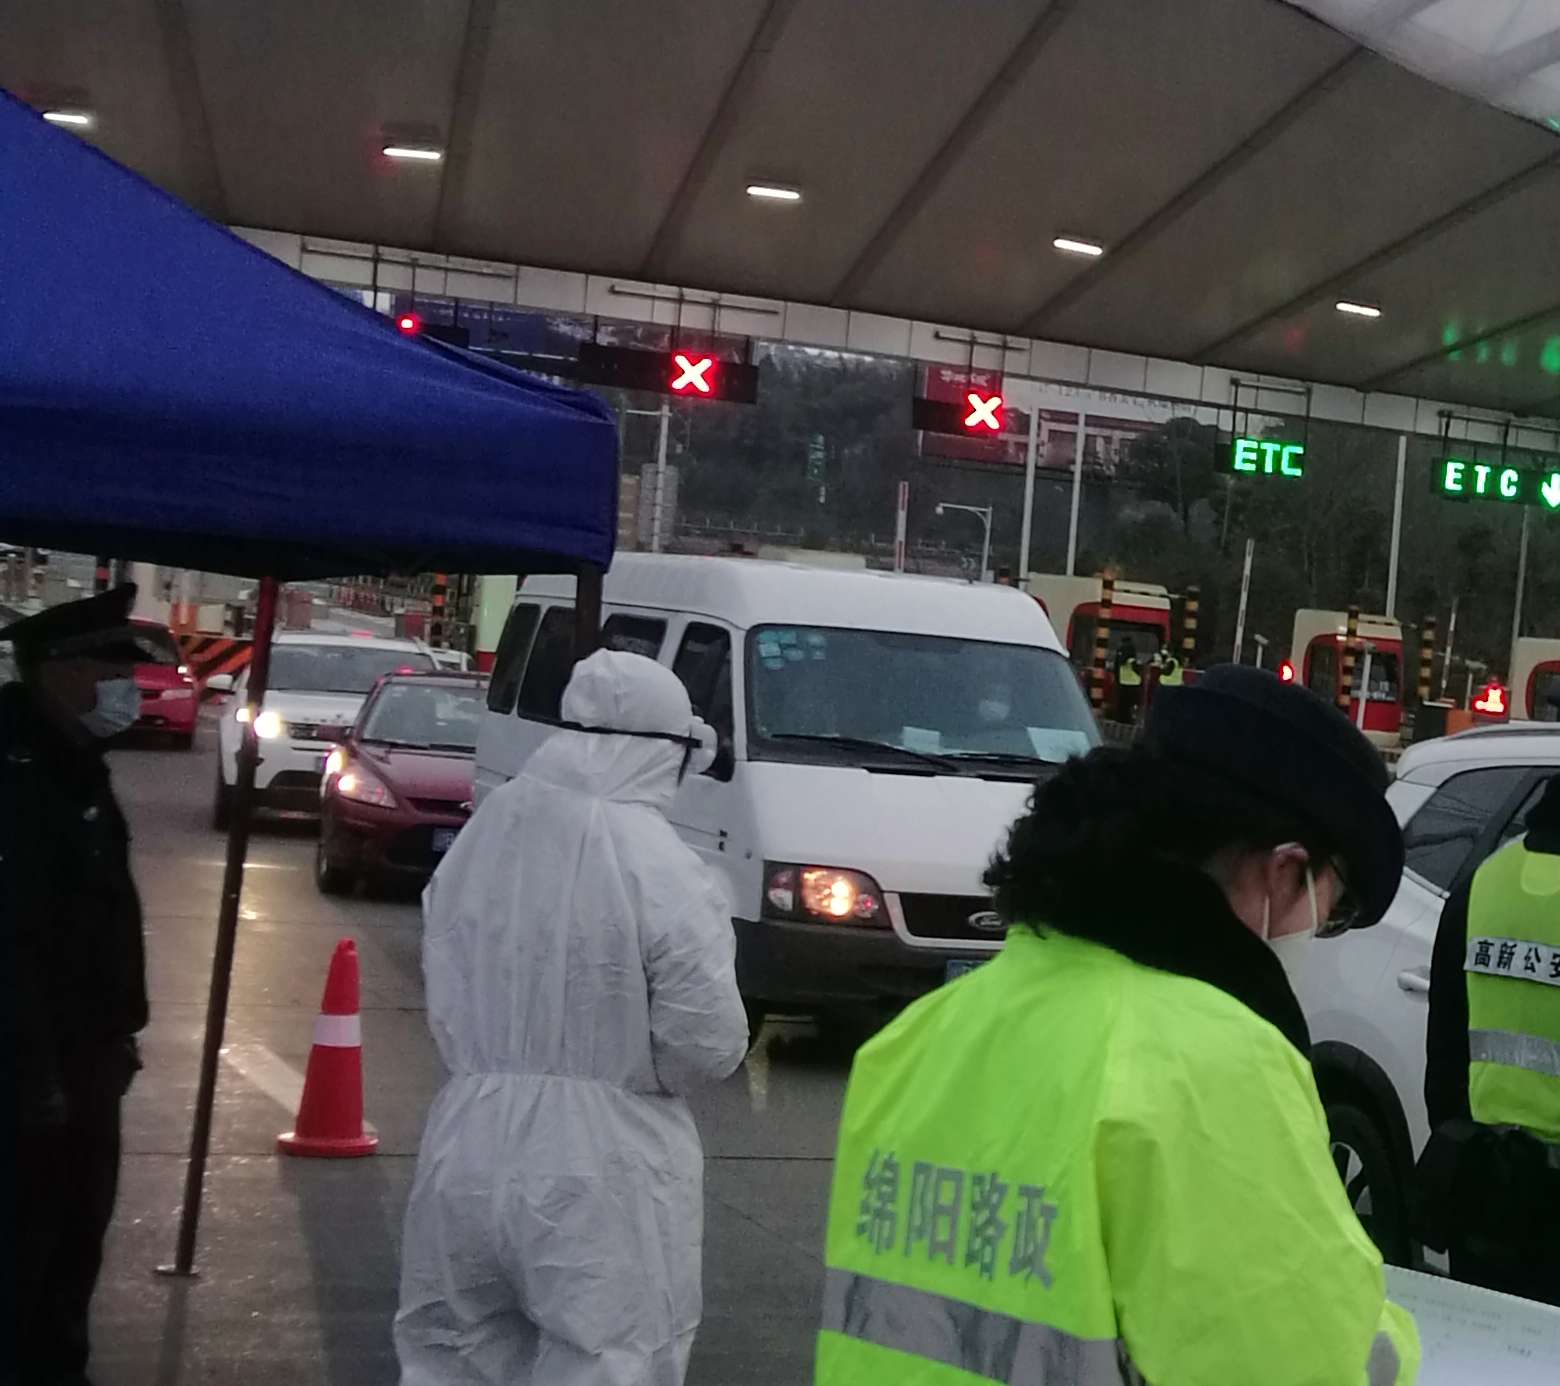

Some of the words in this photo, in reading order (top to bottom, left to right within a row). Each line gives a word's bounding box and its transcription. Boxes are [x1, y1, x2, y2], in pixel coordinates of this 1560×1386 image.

[1233, 438, 1305, 478] ETC
[1444, 461, 1520, 498] ETC
[856, 1147, 1058, 1290] 绵阳路政
